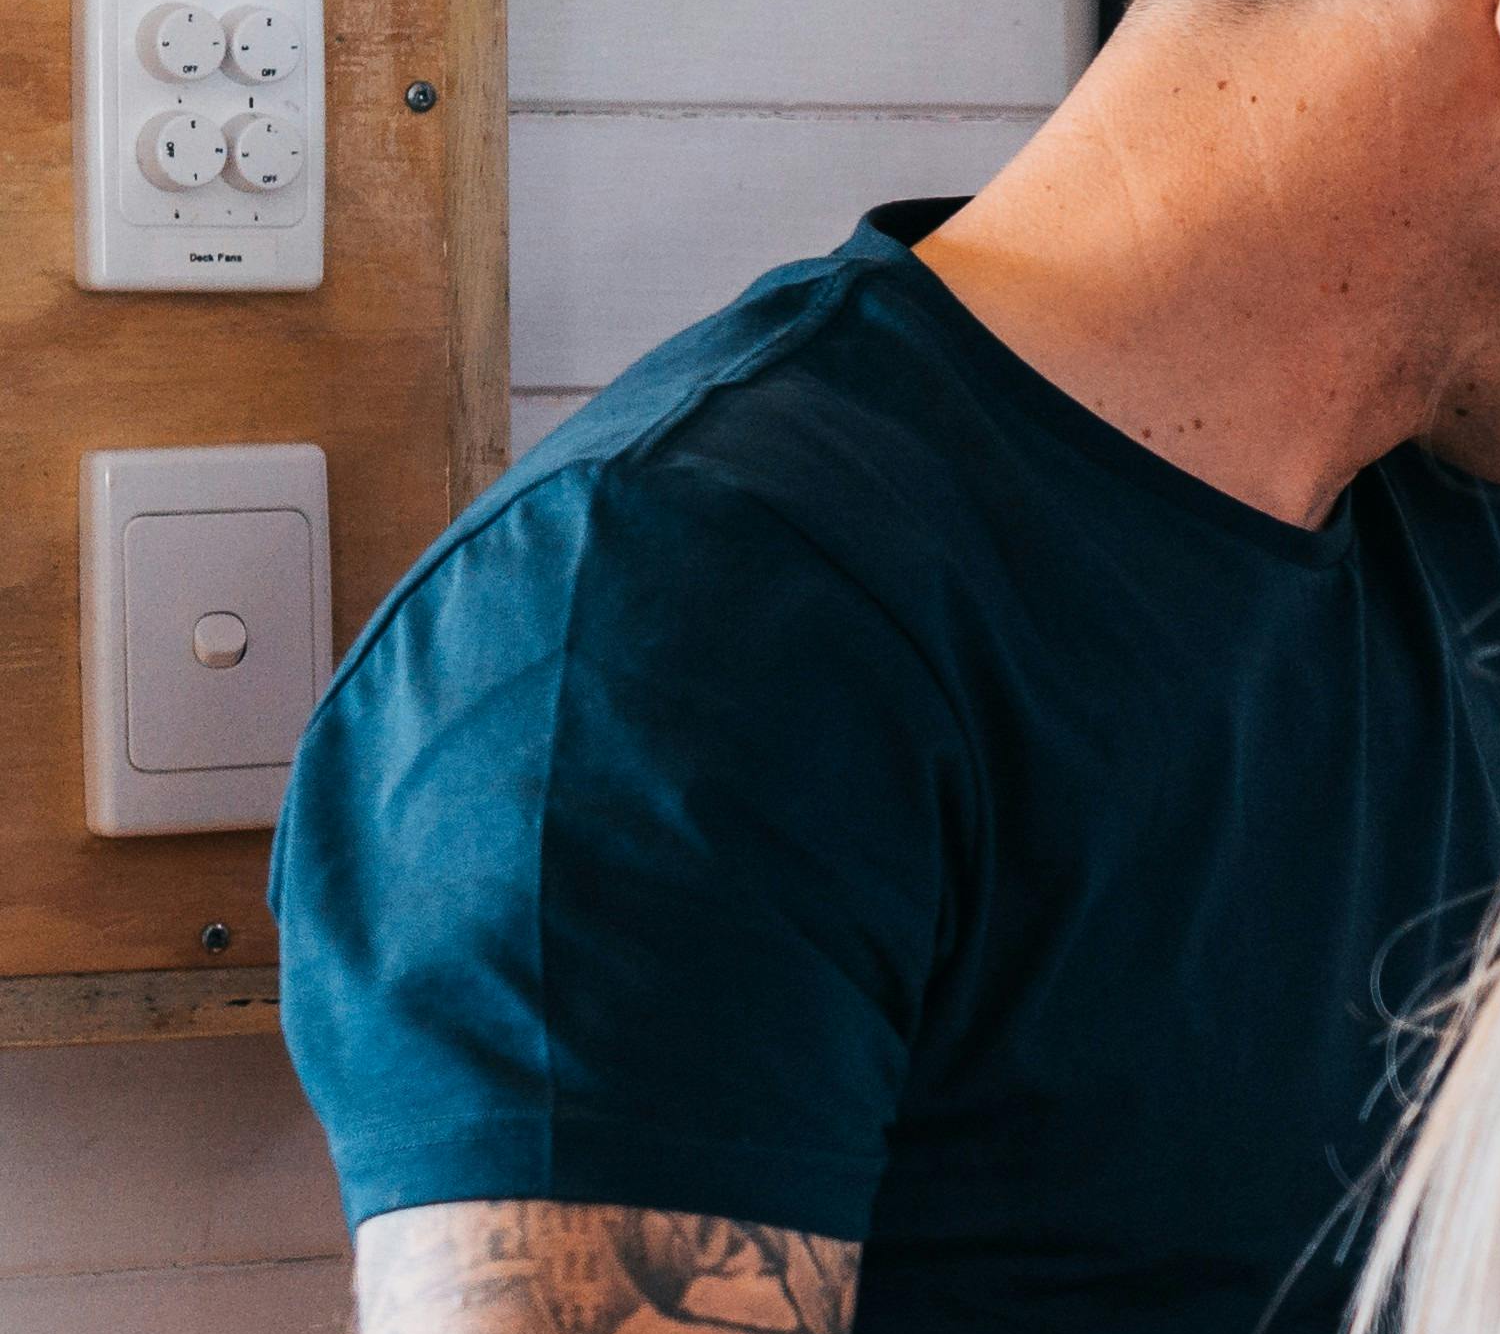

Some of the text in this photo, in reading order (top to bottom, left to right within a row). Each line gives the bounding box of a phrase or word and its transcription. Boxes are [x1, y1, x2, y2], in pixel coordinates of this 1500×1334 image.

[182, 65, 198, 74] OFF
[261, 68, 277, 77] OFF
[166, 142, 175, 158] OFF
[262, 175, 277, 184] OFF
[190, 253, 242, 262] Deck Fans
